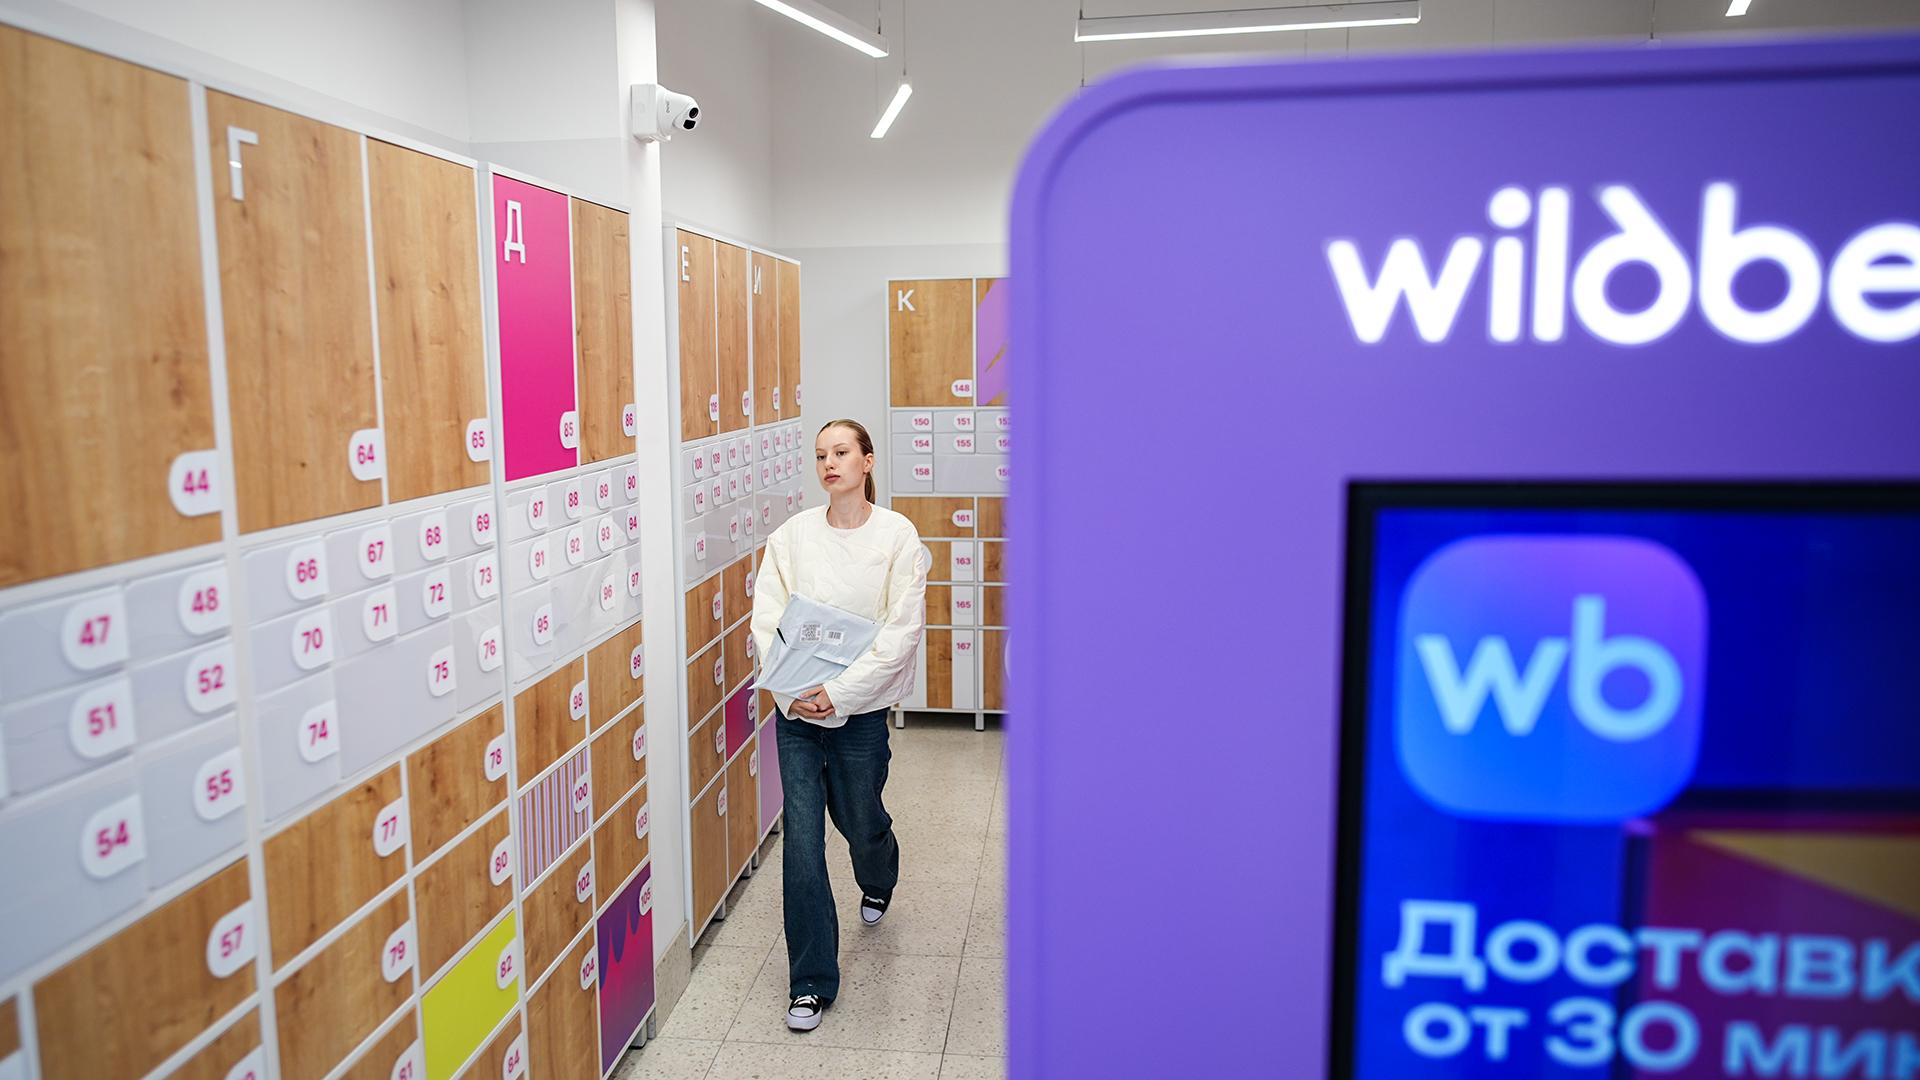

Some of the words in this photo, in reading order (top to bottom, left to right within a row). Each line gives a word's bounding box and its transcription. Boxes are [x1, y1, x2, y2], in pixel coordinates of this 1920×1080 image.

[227, 126, 259, 201] Г
[504, 199, 526, 264] Д
[954, 384, 970, 392] 148
[563, 420, 575, 438] 85
[624, 412, 635, 427] 86
[914, 418, 930, 426] 150
[998, 417, 1012, 425] 15
[471, 430, 487, 449] 65
[914, 439, 930, 447] 154
[956, 439, 972, 447] 155
[998, 439, 1010, 448] 15
[355, 444, 377, 465] 64
[627, 475, 637, 490] 90
[914, 468, 930, 476] 158
[182, 470, 210, 496] 44
[599, 484, 609, 498] 89
[532, 500, 545, 519] 87
[568, 491, 580, 509] 88
[476, 512, 491, 533] 69
[629, 515, 638, 530] 94
[956, 514, 970, 522] 161
[425, 526, 443, 549] 68
[600, 527, 610, 542] 93
[367, 540, 386, 566] 67
[570, 538, 581, 555] 92
[535, 550, 545, 568] 91
[955, 557, 972, 566] 163
[295, 558, 320, 587] 66
[477, 564, 491, 585] 73
[630, 570, 640, 586] 97
[191, 586, 219, 615] 48
[428, 581, 445, 605] 72
[602, 585, 613, 600] 96
[370, 603, 388, 627] 71
[956, 600, 972, 609] 165
[79, 614, 112, 647] 47
[536, 613, 549, 634] 95
[301, 627, 324, 654] 70
[482, 638, 497, 660] 76
[956, 642, 972, 650] 167
[632, 653, 642, 670] 99
[1414, 593, 1685, 744] wb
[197, 662, 225, 696] 52
[432, 660, 449, 685] 75
[572, 691, 584, 712] 98
[87, 703, 117, 738] 51
[307, 719, 329, 746] 74
[634, 734, 645, 753] 101
[488, 746, 503, 770] 78
[207, 768, 234, 803] 55
[575, 782, 588, 804] 100
[381, 815, 398, 842] 77
[637, 812, 647, 830] 103
[95, 821, 130, 858] 54
[494, 851, 509, 876] 80
[576, 872, 590, 894] 102
[641, 882, 652, 903] 105
[218, 923, 244, 962] 57
[389, 938, 407, 966] 79
[499, 955, 513, 979] 82
[581, 956, 595, 981] 104
[1403, 1002, 1529, 1061] от
[1546, 998, 1700, 1071] 30
[506, 1049, 521, 1075] 84
